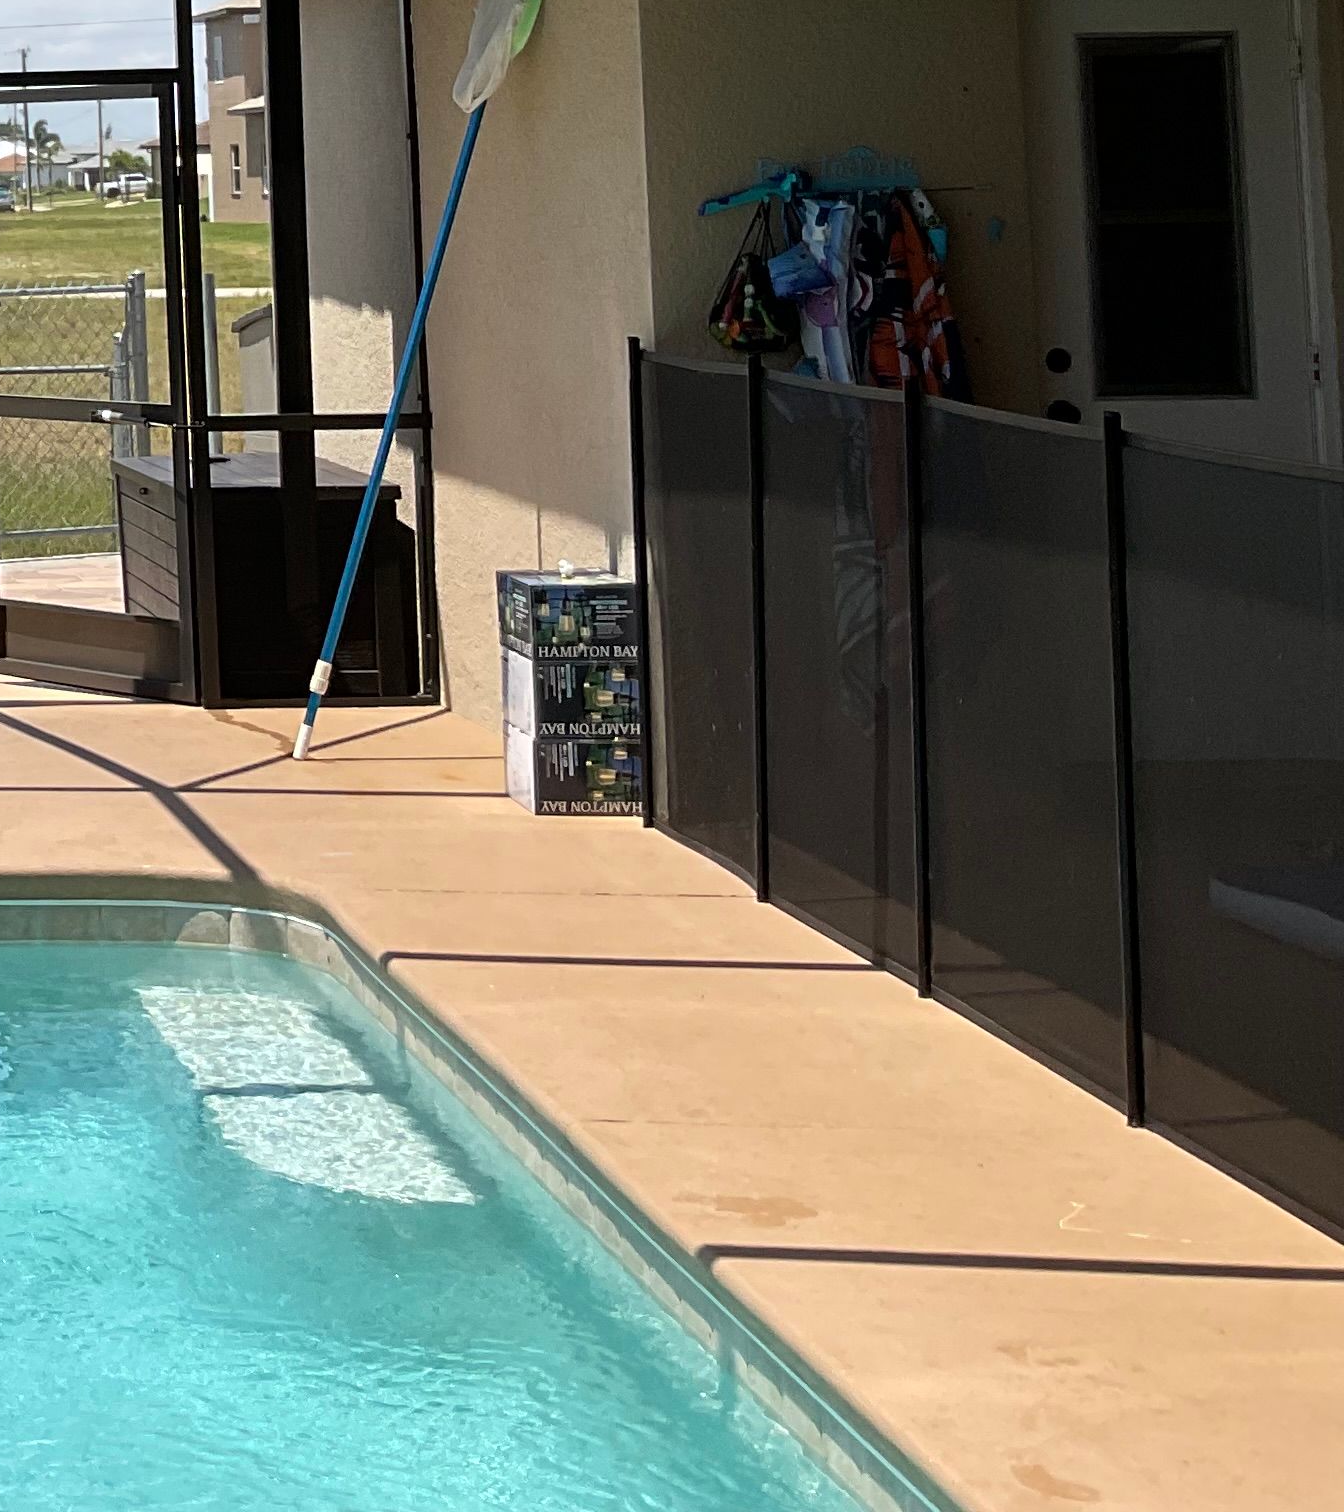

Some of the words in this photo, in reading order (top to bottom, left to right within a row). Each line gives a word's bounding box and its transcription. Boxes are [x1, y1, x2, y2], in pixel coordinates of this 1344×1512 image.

[613, 645, 639, 658] BAY
[539, 722, 566, 735] BAY
[569, 723, 641, 735] HAMPTON
[540, 800, 567, 813] BAY
[570, 801, 643, 813] HAMPTON
